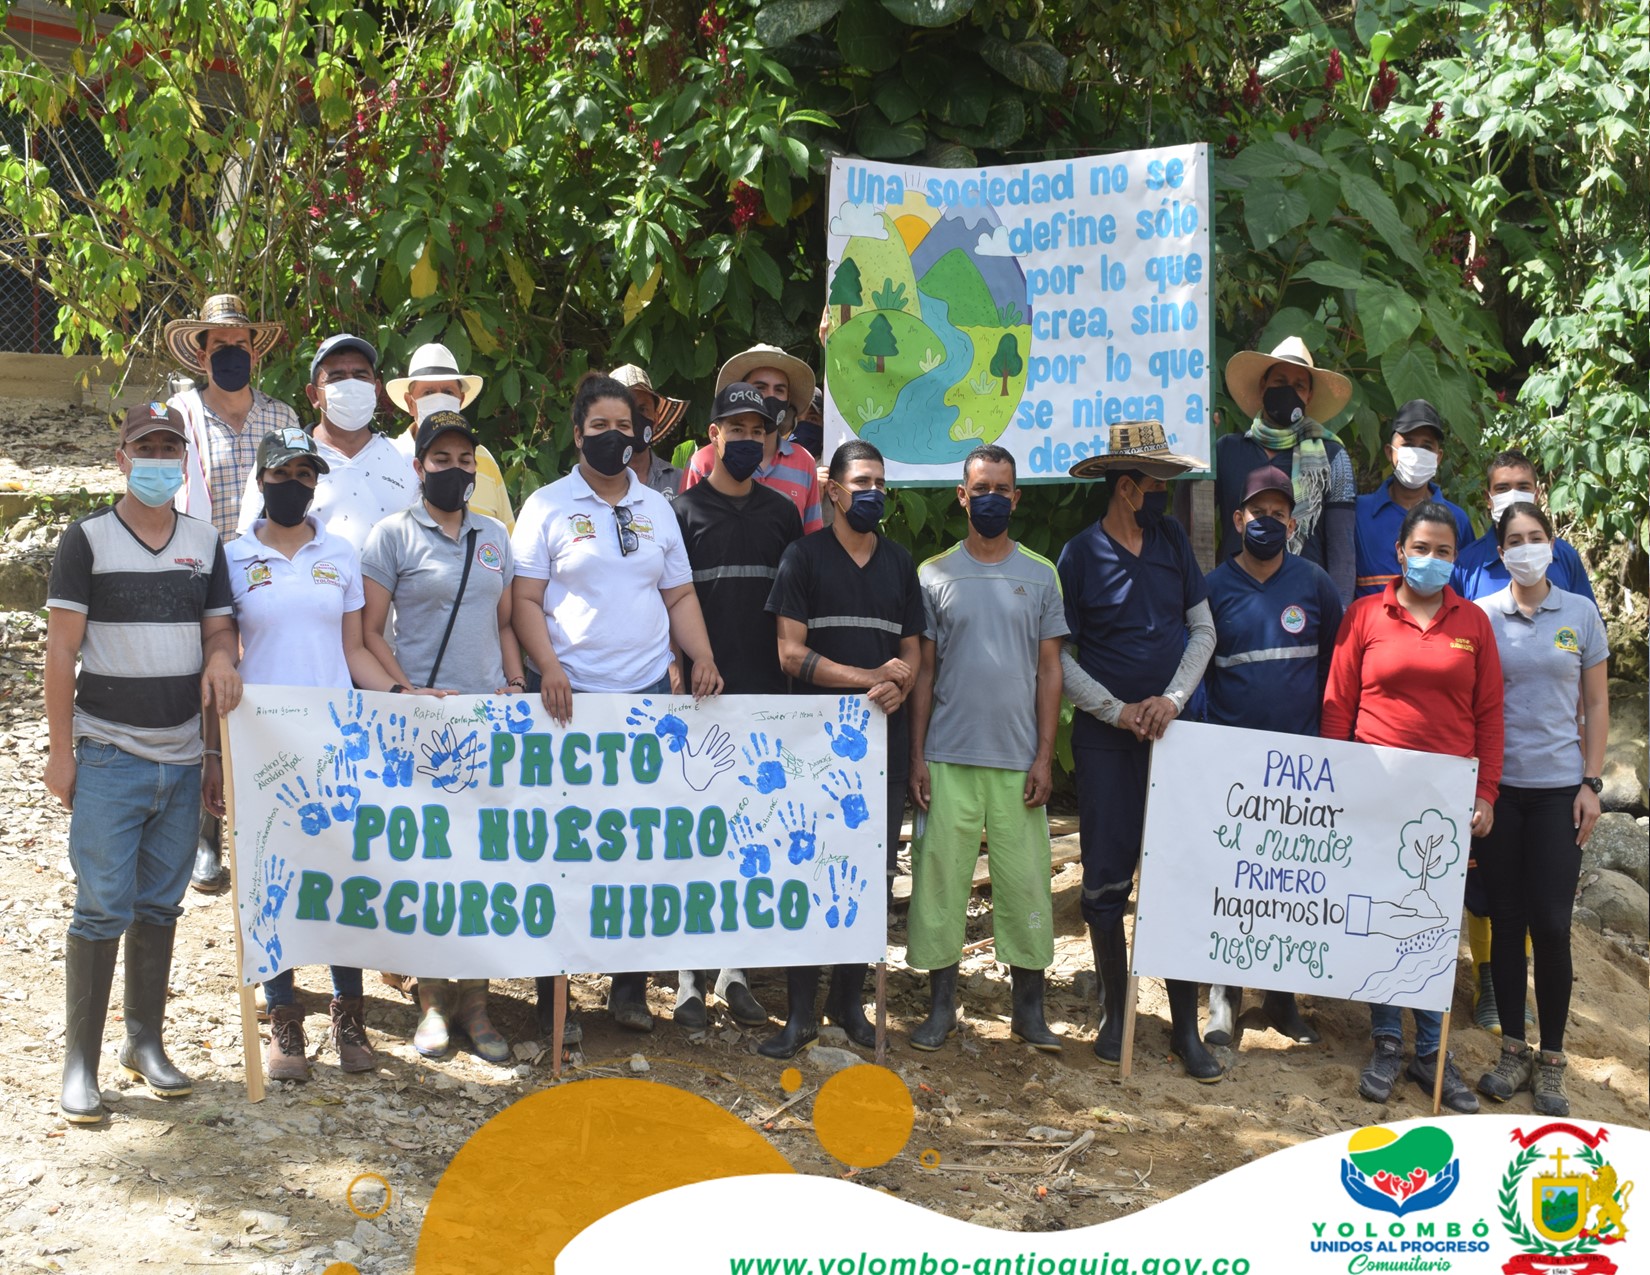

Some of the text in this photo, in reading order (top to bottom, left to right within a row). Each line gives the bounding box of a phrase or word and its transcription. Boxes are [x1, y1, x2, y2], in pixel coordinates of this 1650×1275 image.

[846, 157, 1184, 208] Una sociedad no se
[1008, 198, 1199, 254] define sólo
[1026, 253, 1203, 305] por lo que
[1032, 296, 1198, 341] crea, sino
[1027, 346, 1204, 391] por lo que
[1016, 391, 1204, 430] se niega a
[488, 731, 663, 787] PACTO
[1263, 750, 1335, 793] PARA
[1226, 782, 1344, 828] Cambiar
[352, 804, 728, 862] POR NUESTRO
[1213, 822, 1241, 851] el
[1235, 859, 1326, 894] PRIMERO
[296, 870, 556, 938] RECURSO
[590, 877, 811, 939] HIDRICO
